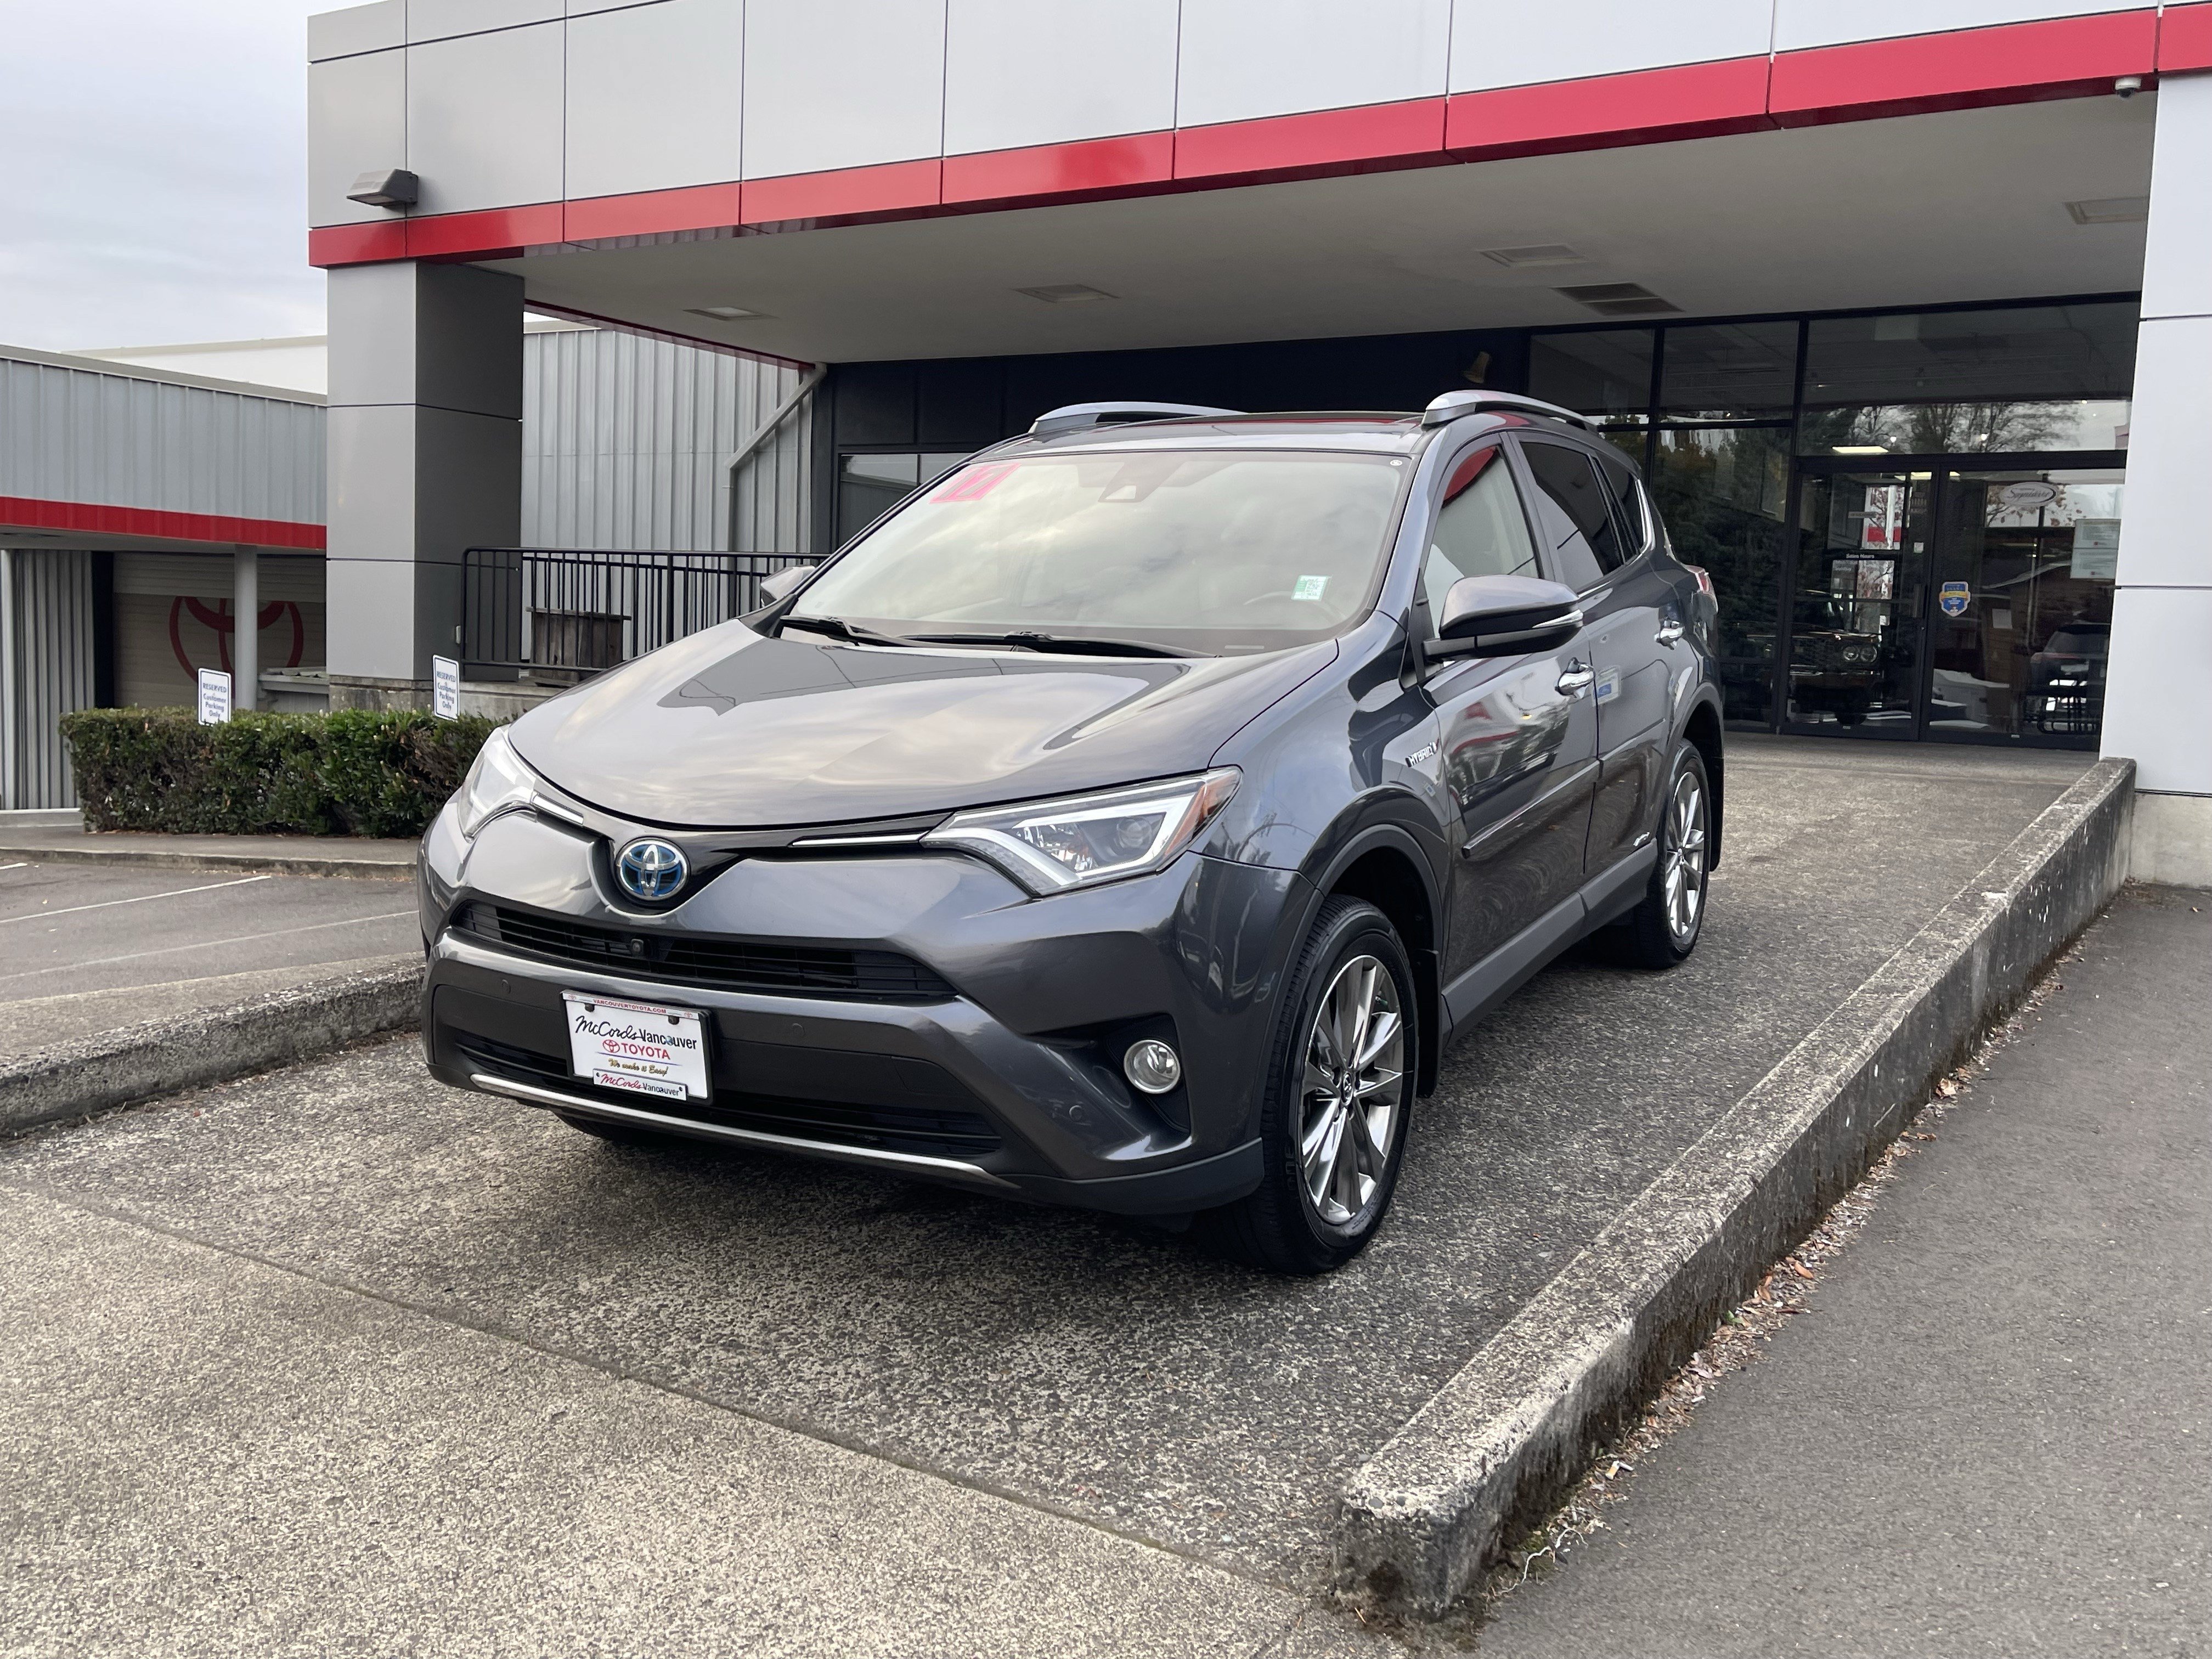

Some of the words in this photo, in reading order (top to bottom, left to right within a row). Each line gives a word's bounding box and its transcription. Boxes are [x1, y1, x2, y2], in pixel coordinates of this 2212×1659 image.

[437, 671, 456, 682] RESERVED
[203, 682, 227, 693] RESERVED
[438, 682, 456, 693] Customer
[203, 693, 226, 703] Customer
[439, 691, 454, 704] Parking
[205, 701, 224, 713] Parking
[442, 701, 451, 711] Only
[1408, 746, 1434, 766] HYBRID
[593, 998, 667, 1013] VANCOUVERTOYOTA.COM
[621, 1043, 670, 1060] TOYOTA
